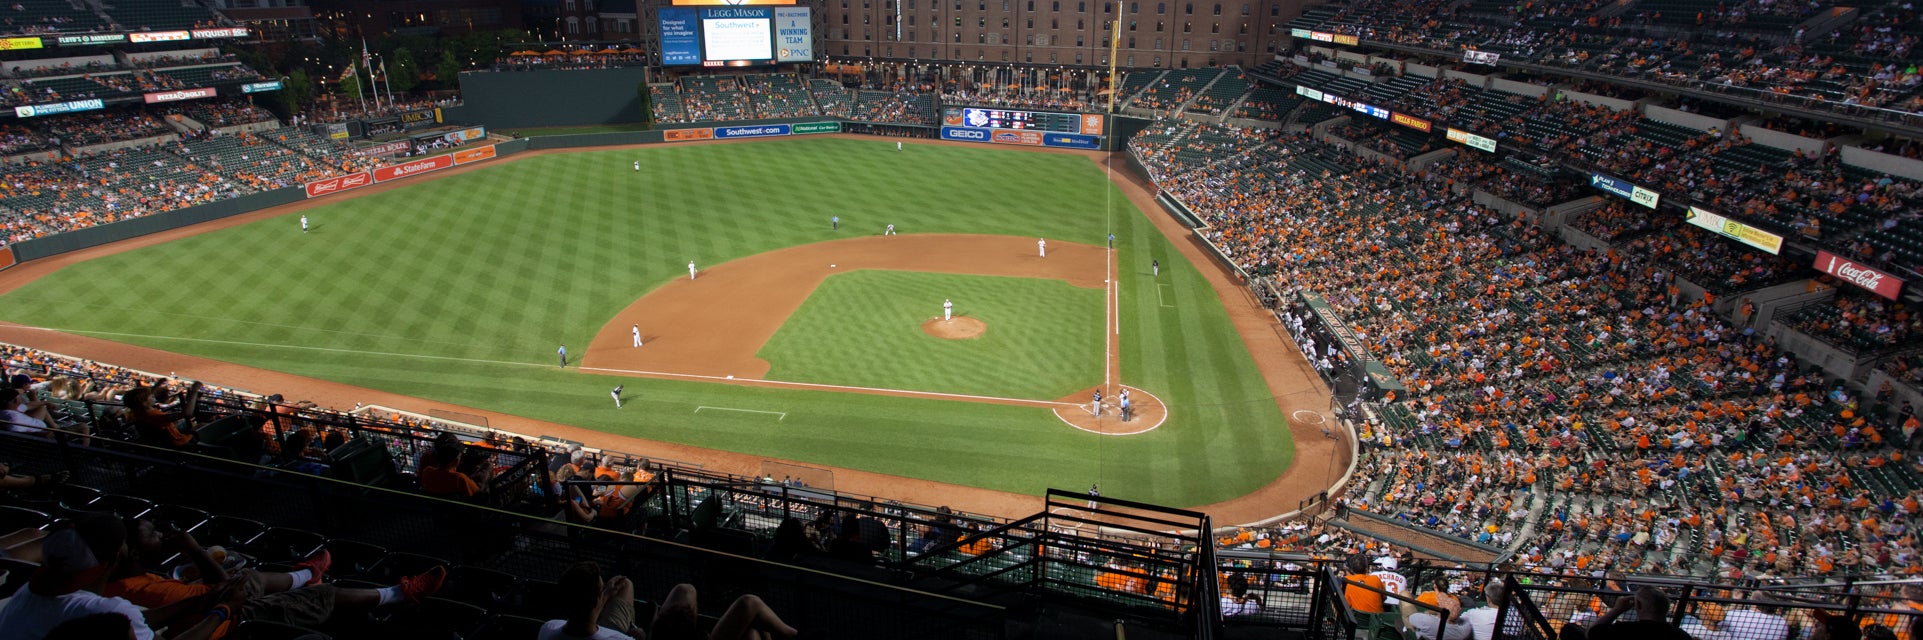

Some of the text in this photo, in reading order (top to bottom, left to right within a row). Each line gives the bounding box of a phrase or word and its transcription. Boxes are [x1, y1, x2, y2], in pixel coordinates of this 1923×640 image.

[708, 9, 764, 17] LEGG MASON
[780, 28, 808, 36] WINNING
[69, 98, 103, 110] UNION
[1394, 114, 1427, 129] WELLS FARGO
[950, 129, 984, 139] GEICO
[1378, 573, 1404, 583] ACHADO
